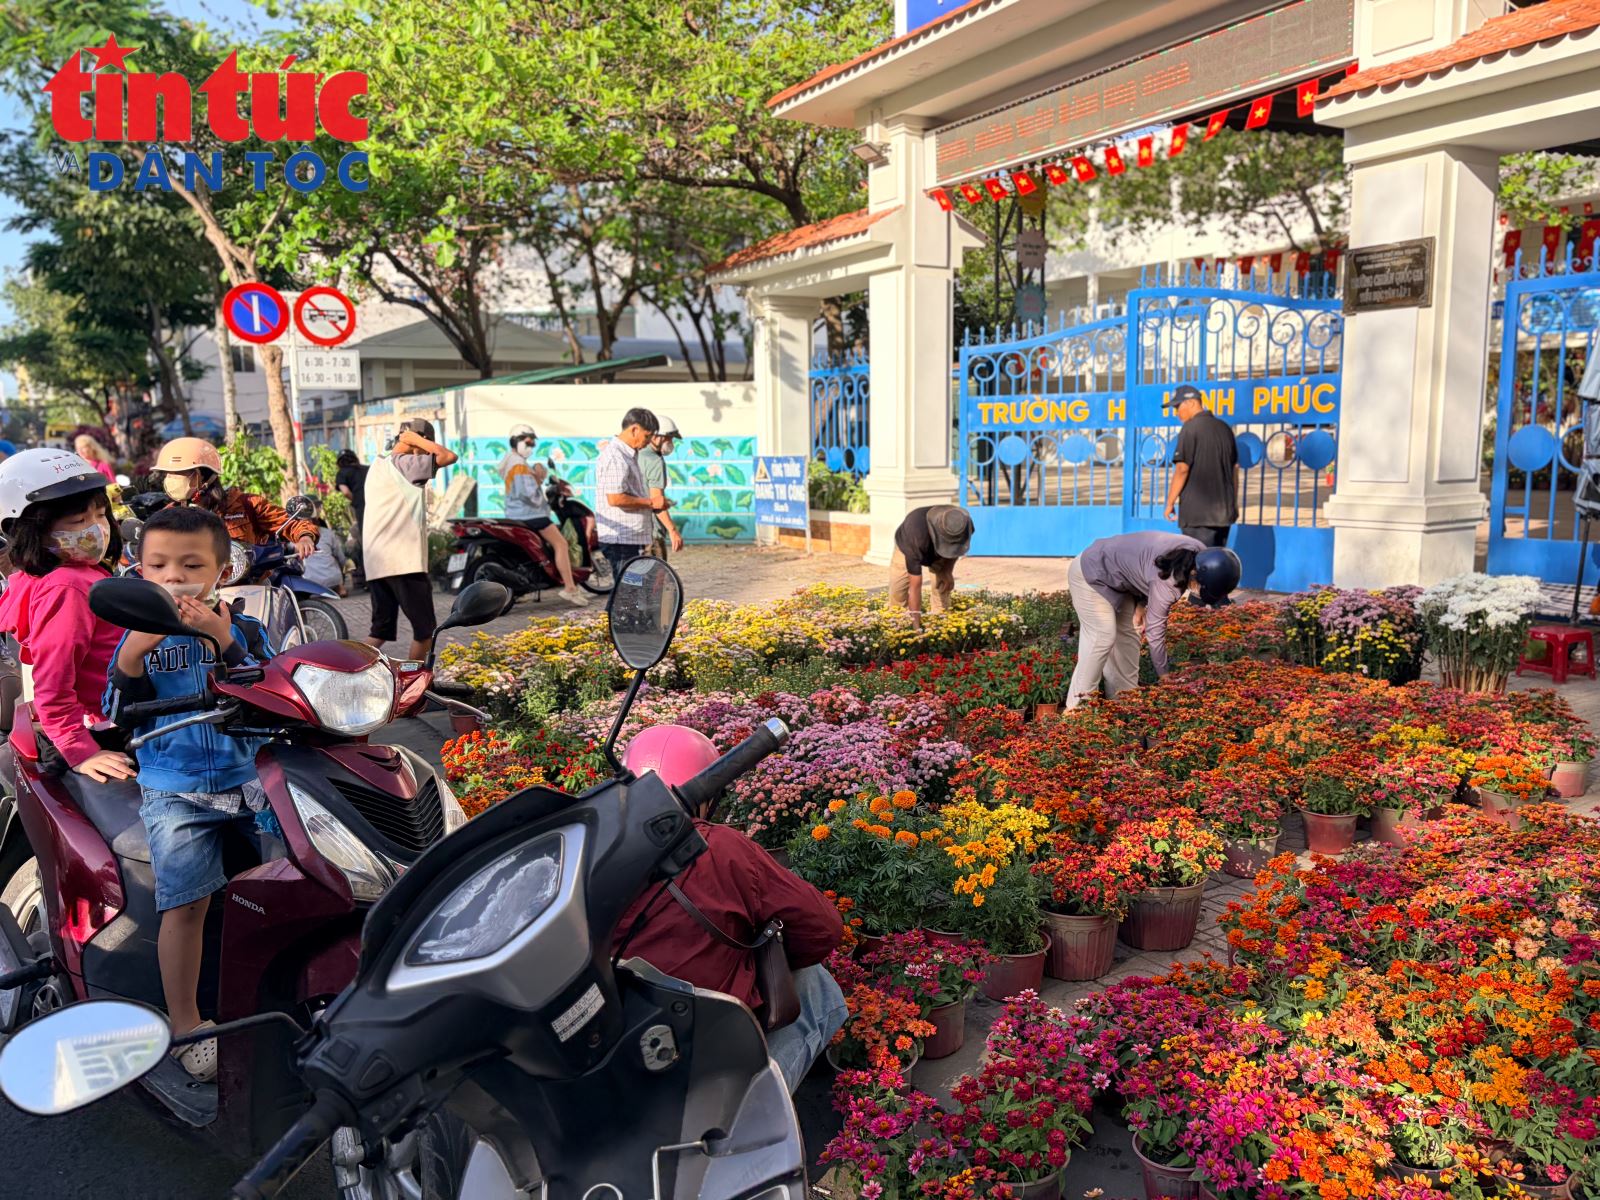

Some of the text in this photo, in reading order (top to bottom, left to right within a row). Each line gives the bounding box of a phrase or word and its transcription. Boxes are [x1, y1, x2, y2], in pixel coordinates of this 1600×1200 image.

[304, 357, 324, 367] 6:30
[332, 357, 351, 367] 7:30
[301, 372, 325, 383] 16:30
[333, 373, 356, 383] 18:30
[977, 395, 1090, 425] TRƯỜNG
[1162, 388, 1235, 417] HNH
[1252, 377, 1336, 416] PHÚC
[232, 893, 266, 915] HONDA
